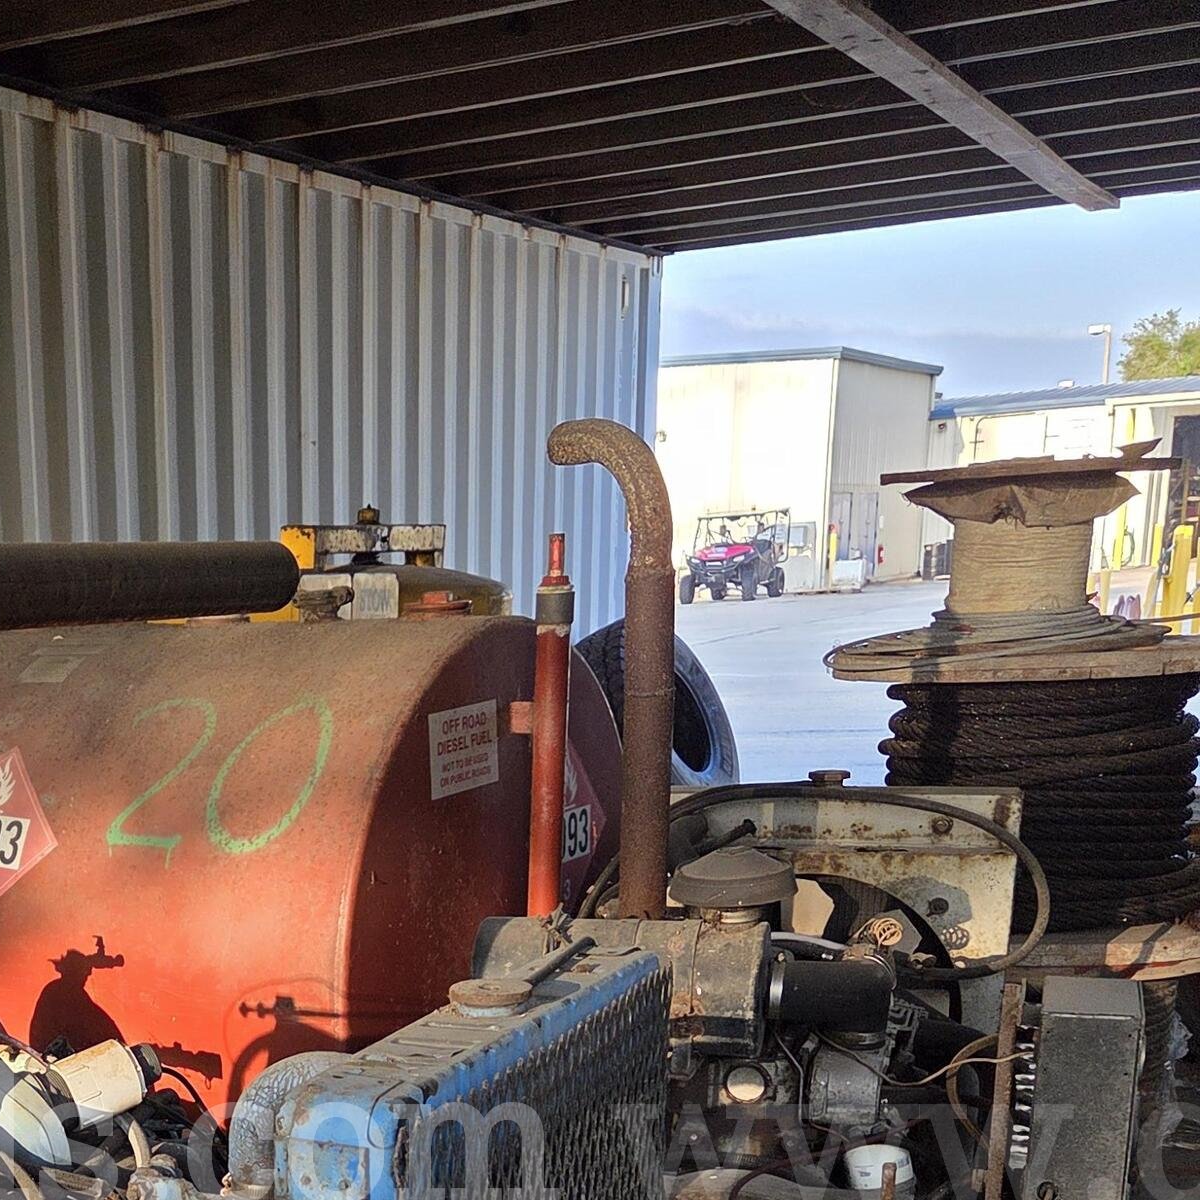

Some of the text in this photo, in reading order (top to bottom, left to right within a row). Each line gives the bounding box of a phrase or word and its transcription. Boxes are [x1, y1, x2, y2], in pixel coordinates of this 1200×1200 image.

[442, 711, 487, 735] OFF ROAD
[437, 730, 493, 756] DIESEL FUEL
[106, 694, 333, 857] 20
